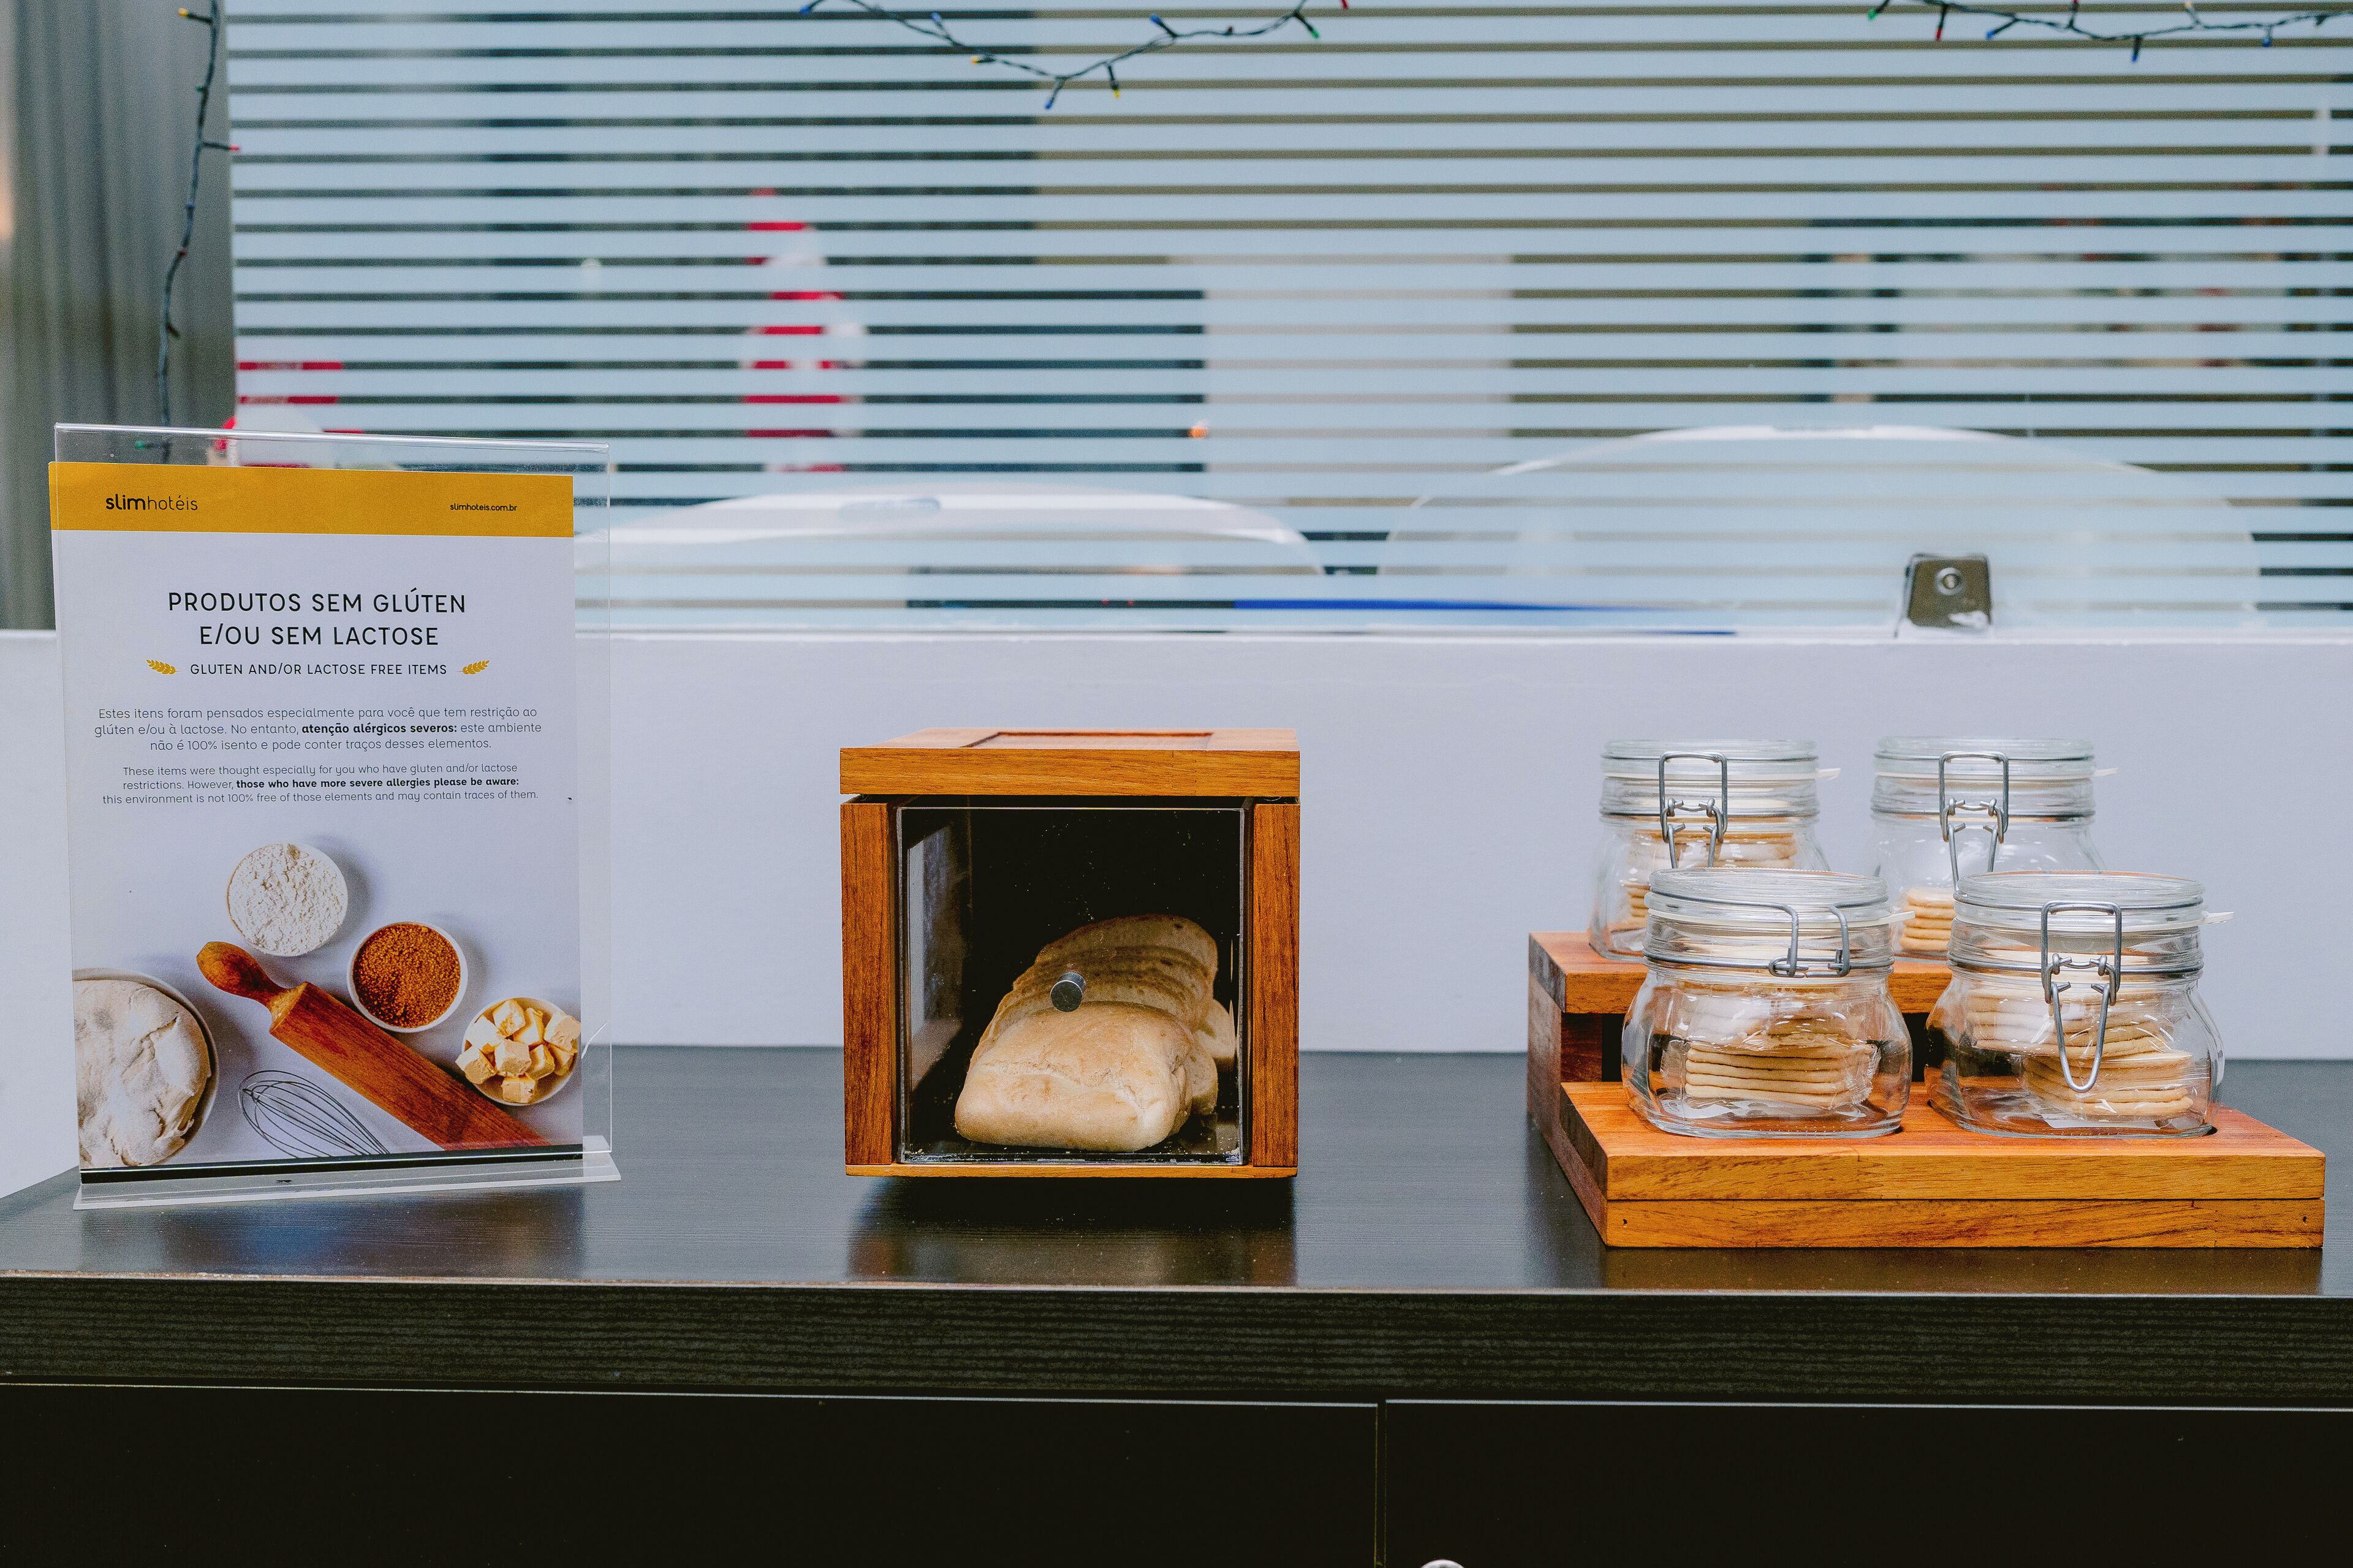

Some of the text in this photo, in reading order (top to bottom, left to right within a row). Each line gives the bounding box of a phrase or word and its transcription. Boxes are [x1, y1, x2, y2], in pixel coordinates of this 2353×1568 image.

[105, 493, 199, 511] slimhotéis
[450, 502, 518, 512] slimhoteis.com.br
[168, 586, 465, 613] PRODUTOS SEM GLÚTEN
[200, 623, 439, 646] E/OU SEM LACTOSE
[190, 662, 447, 675] GLUTEN AND/OR LACTOSE FREE ITEMS
[99, 706, 537, 721] Estes itens foram pensados especialmente para você que tem restrição ao
[94, 722, 542, 738] glúten e/ou à lactose. No entanto, atenção alérgicos severos: este ambiente
[150, 738, 491, 752] não é 100% isento e pode conter traços desses elementos.
[123, 767, 154, 776] These
[157, 767, 187, 776] items
[218, 765, 260, 778] thought
[262, 765, 316, 777] especially
[319, 765, 333, 774] for
[335, 767, 355, 777] you
[358, 764, 380, 774] who
[382, 764, 407, 773] have
[409, 764, 443, 776] gluten
[445, 762, 479, 773] and/or
[481, 763, 518, 773] lactose
[123, 781, 184, 790] restrictions.
[188, 780, 234, 790] However,
[235, 779, 265, 789] those
[267, 779, 289, 789] who
[292, 779, 317, 788] have
[385, 777, 431, 789] allergies
[433, 777, 468, 789] please
[470, 777, 483, 786] be
[102, 790, 539, 805] this environment is not 100% free of those elements and may contain traces of them.
